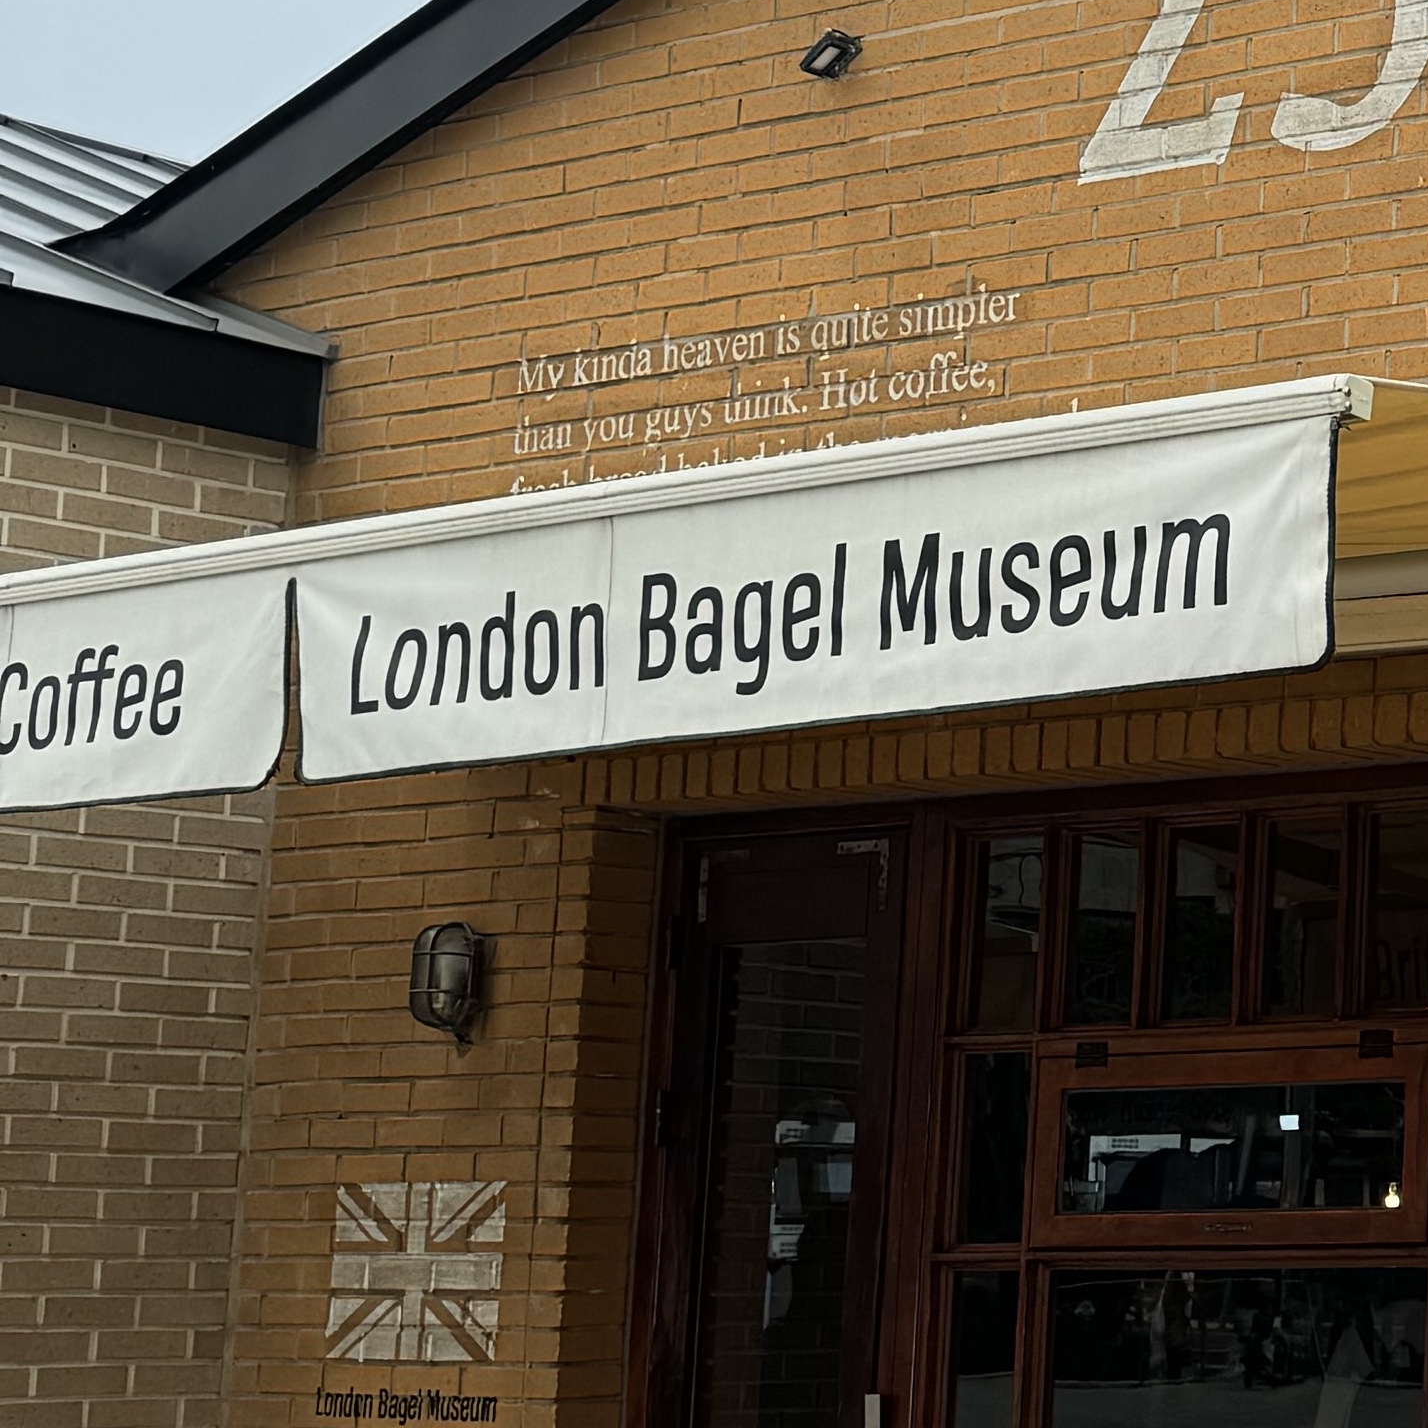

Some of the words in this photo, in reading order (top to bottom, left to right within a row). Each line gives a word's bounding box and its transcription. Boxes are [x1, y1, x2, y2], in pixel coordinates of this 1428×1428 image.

[517, 354, 564, 401] My
[572, 338, 653, 386] kinda
[663, 329, 766, 371] heaven
[777, 314, 800, 355] is
[811, 303, 888, 360] quite
[899, 283, 1021, 340] simpler
[513, 415, 572, 455] than
[584, 411, 634, 451] you
[645, 400, 713, 447] guys
[819, 368, 879, 411] Hot
[349, 590, 606, 716] London
[637, 543, 848, 696] Bagel
[879, 512, 1232, 651] Museum
[0, 643, 185, 756] Coffee
[316, 1386, 373, 1419] London
[378, 1388, 423, 1426] Bagel
[427, 1389, 498, 1423] Museum
